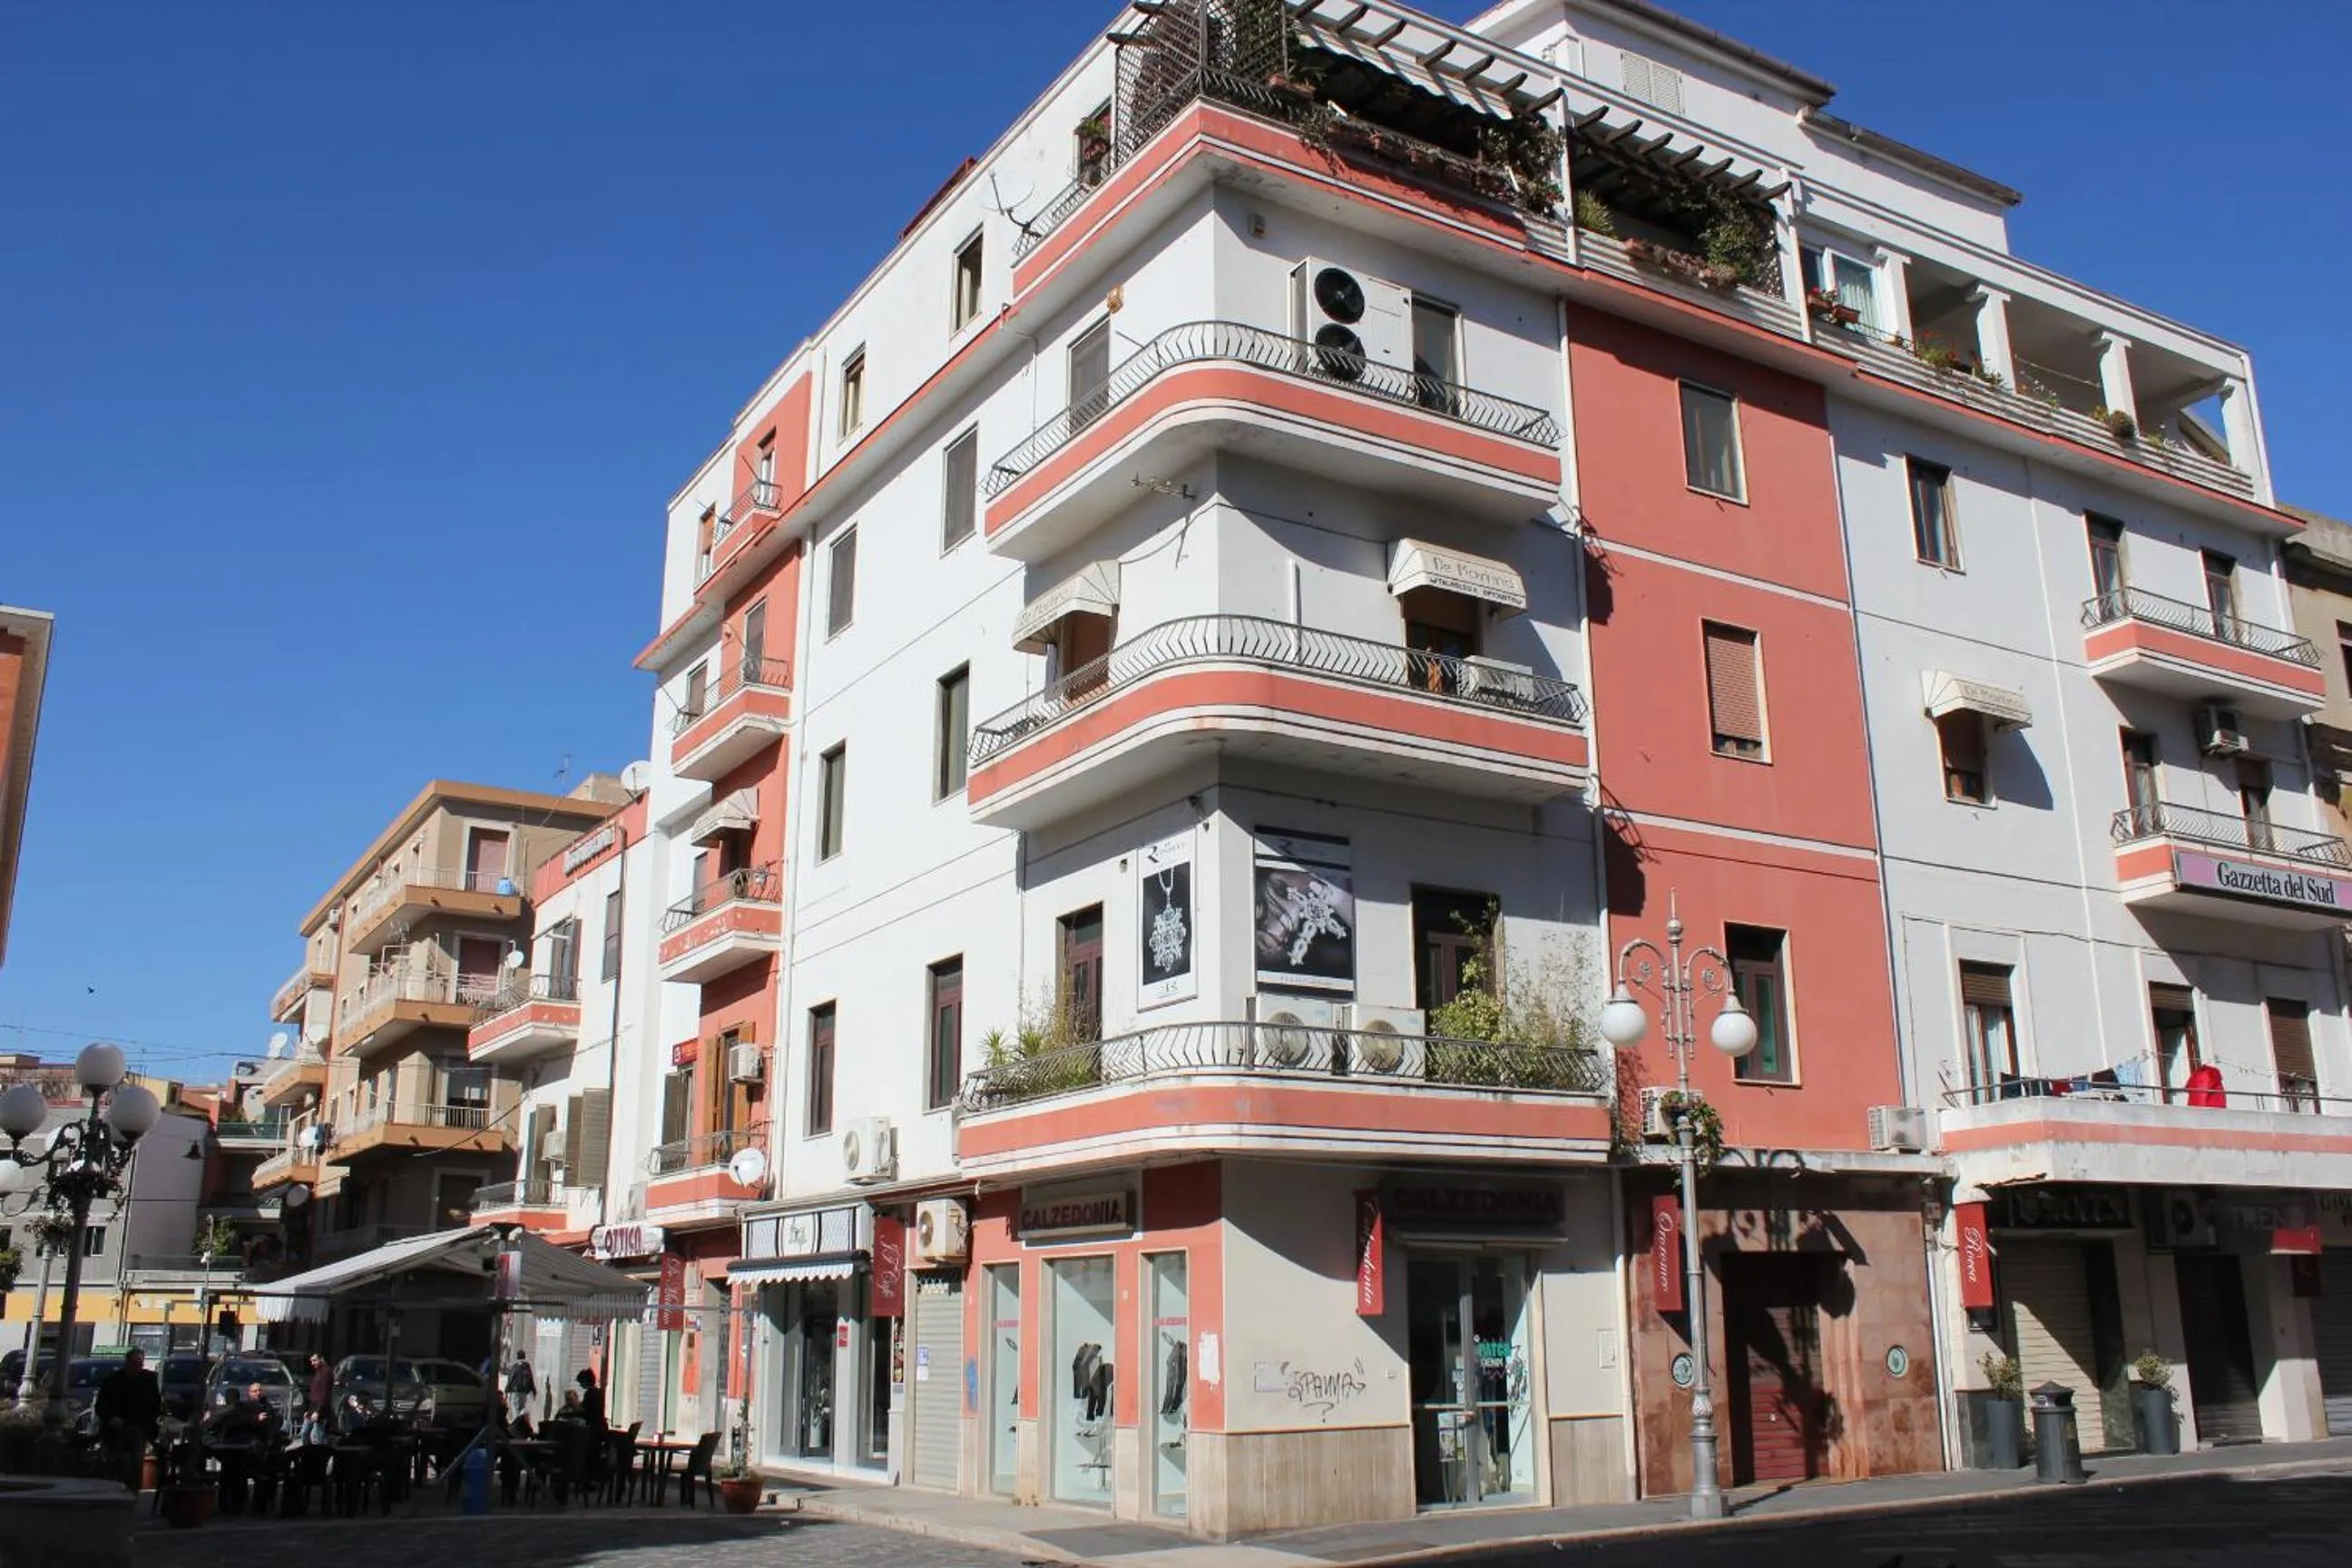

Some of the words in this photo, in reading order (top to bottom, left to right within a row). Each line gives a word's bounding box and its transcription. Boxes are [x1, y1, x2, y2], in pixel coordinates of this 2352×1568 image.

[2217, 861, 2282, 897] Gazzetta
[2284, 873, 2305, 899] del
[2308, 877, 2336, 905] Sud
[1022, 1198, 1122, 1230] CALZEDONIA
[1394, 1187, 1559, 1214] CALZEDONIA
